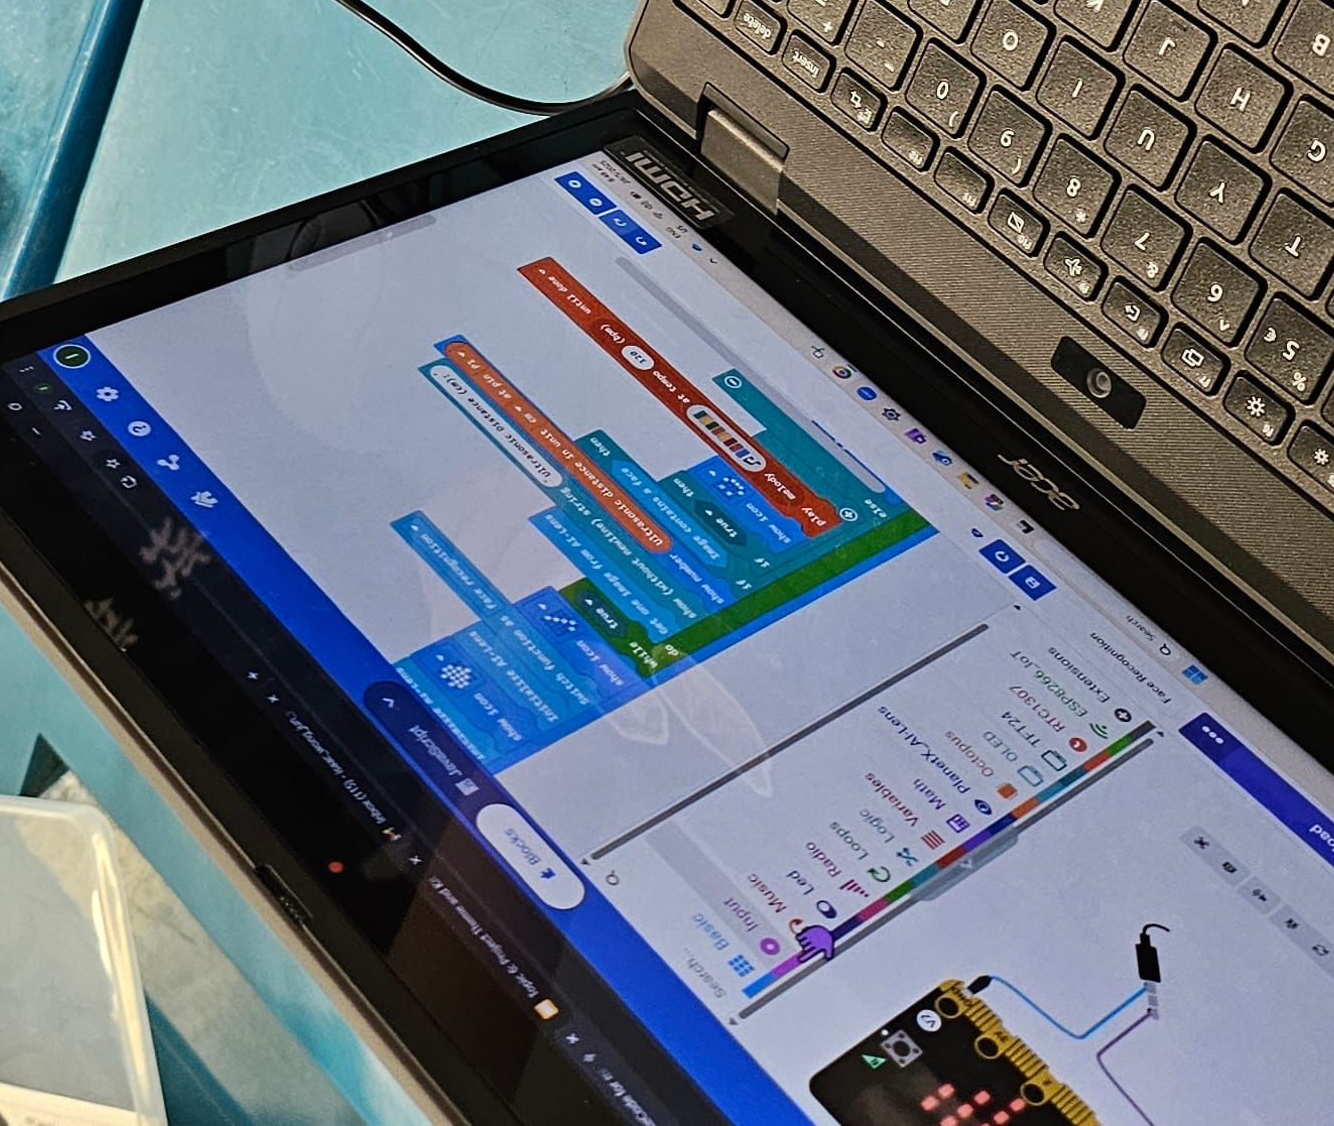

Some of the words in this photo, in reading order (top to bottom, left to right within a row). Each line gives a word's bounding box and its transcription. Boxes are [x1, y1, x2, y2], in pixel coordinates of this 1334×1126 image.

[738, 10, 774, 40] delete
[999, 26, 1023, 53] O
[1156, 34, 1178, 56] J
[1306, 32, 1333, 57] B
[789, 47, 822, 79] insert
[1230, 86, 1253, 111] H
[999, 129, 1015, 148] 9
[1135, 125, 1157, 151] U
[1305, 138, 1328, 163] G
[626, 152, 713, 221] HDMI
[1064, 174, 1083, 198] 8
[1207, 181, 1228, 205] Y
[1133, 231, 1151, 252] 7
[1283, 232, 1304, 258] T
[545, 275, 568, 293] done
[1206, 282, 1223, 303] 6
[566, 293, 591, 314] until
[599, 323, 625, 344] (bpm)
[1281, 339, 1299, 360] 5
[482, 373, 502, 387] pin
[652, 369, 676, 392] tempo
[497, 388, 512, 398] at
[676, 393, 690, 403] at
[467, 397, 504, 431] Distance
[522, 411, 537, 423] cm
[539, 428, 561, 447] unit
[587, 436, 612, 457] then
[561, 448, 574, 460] in
[573, 461, 613, 497] distance
[620, 466, 642, 486] face
[673, 477, 694, 497] then
[763, 472, 796, 499] melody
[997, 454, 1079, 509] acer
[559, 486, 590, 515] string
[745, 502, 768, 521] icon
[864, 498, 887, 518] else
[614, 499, 663, 545] Ultrasonic
[652, 495, 691, 532] contains
[801, 506, 826, 526] play
[590, 517, 632, 555] newline)
[715, 517, 737, 537] true
[768, 523, 791, 543] show
[420, 533, 473, 585] recognition
[580, 548, 602, 569] from
[692, 535, 719, 559] Image
[666, 551, 702, 583] number
[753, 556, 770, 567] if
[603, 571, 631, 596] image
[631, 557, 673, 595] (without
[735, 578, 752, 589] if
[698, 582, 724, 605] show
[595, 607, 618, 629] true
[629, 597, 651, 616] one
[672, 596, 698, 620] show
[647, 616, 670, 635] Get
[1125, 614, 1153, 641] Search
[513, 628, 558, 672] function
[573, 638, 600, 661] icon
[626, 639, 657, 668] while
[662, 642, 680, 657] do
[1089, 631, 1147, 682] Recognition
[597, 662, 625, 687] show
[1048, 646, 1110, 703] Extensions
[473, 691, 499, 716] icon
[505, 669, 560, 723] Initialize
[1145, 681, 1171, 704] Face
[1008, 684, 1065, 732] RTC1307
[494, 716, 524, 742] show
[1000, 710, 1040, 746] TFT24
[409, 724, 462, 775] JavaScript
[878, 705, 970, 793] PlanetX_AI-Lens
[945, 730, 994, 777] Octopus
[982, 730, 1018, 762] OLED
[865, 772, 918, 826] Variables
[913, 777, 946, 810] Math
[859, 809, 895, 843] Logic
[501, 827, 541, 866] Blocks
[829, 820, 869, 860] Loops
[805, 841, 841, 877] Radio
[749, 873, 787, 913] Music
[786, 869, 814, 895] Led
[723, 897, 758, 932] Input
[692, 912, 730, 952] Basic
